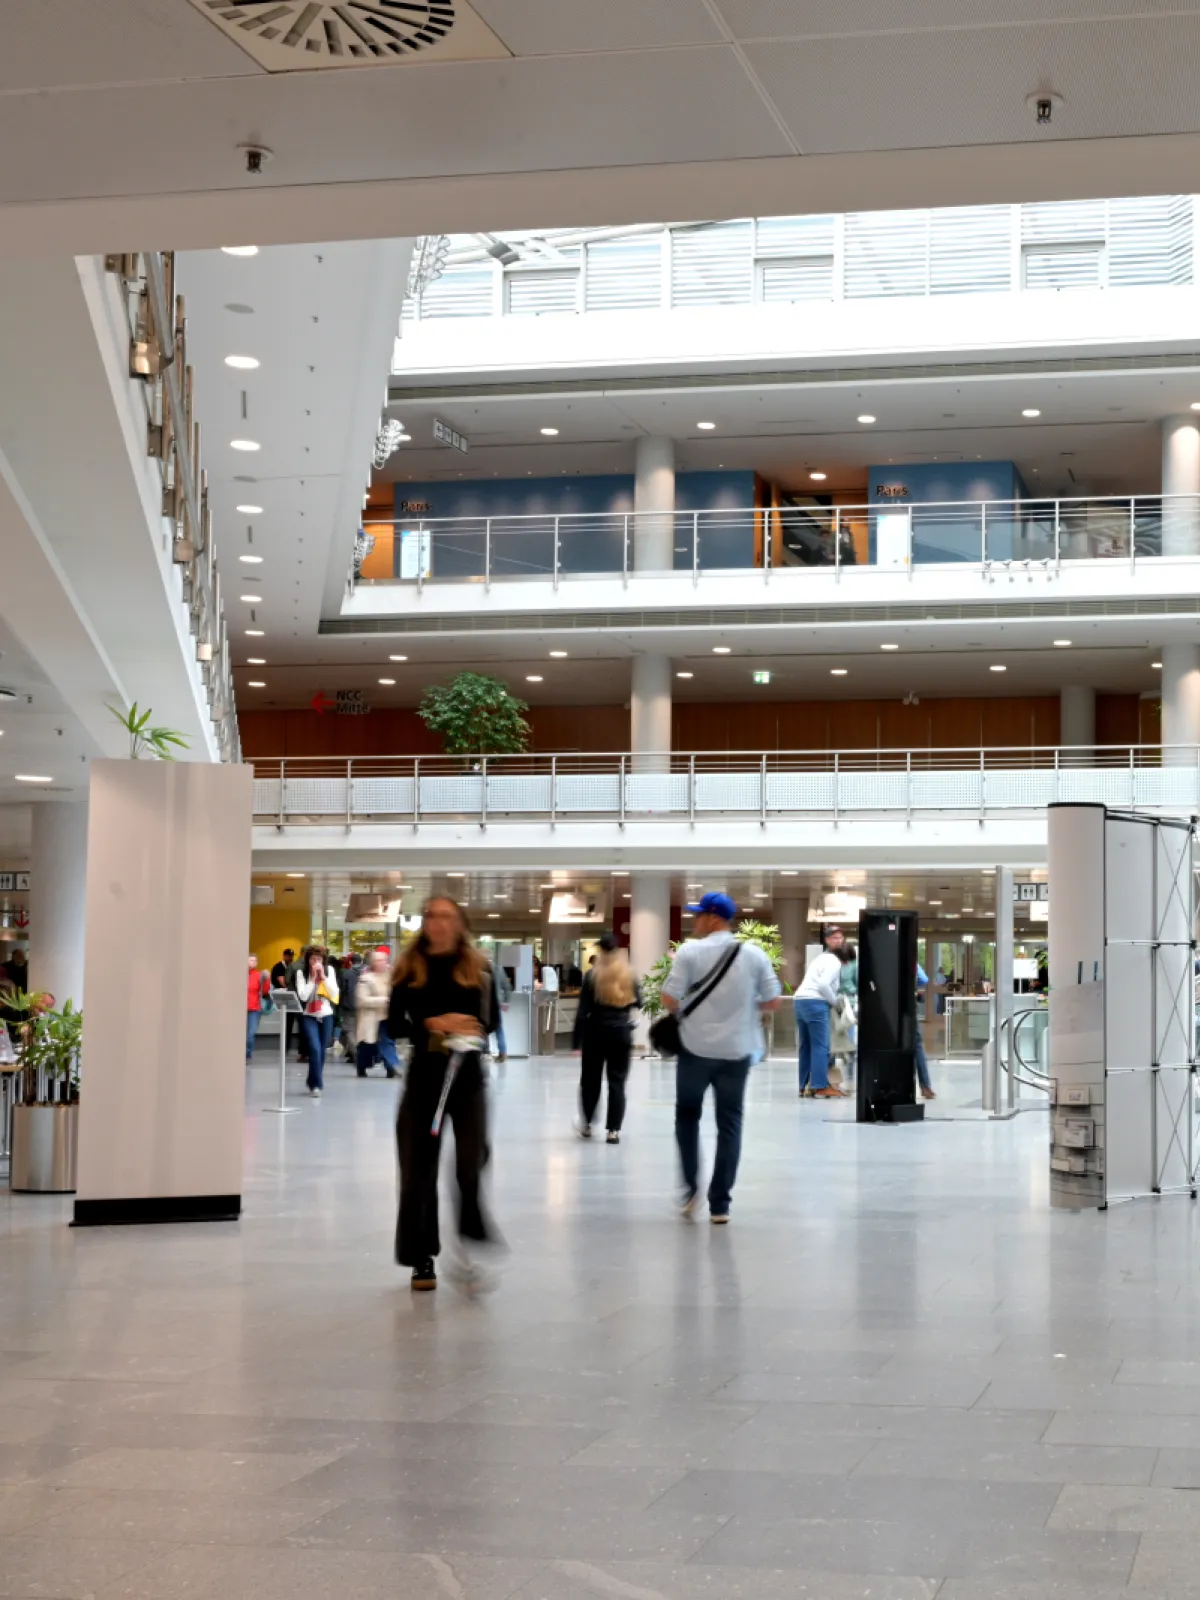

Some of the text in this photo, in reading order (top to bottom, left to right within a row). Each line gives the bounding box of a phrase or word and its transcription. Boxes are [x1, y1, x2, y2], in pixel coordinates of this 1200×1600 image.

[877, 485, 908, 497] Paris
[336, 690, 362, 701] NCC
[336, 702, 369, 713] Mitte
